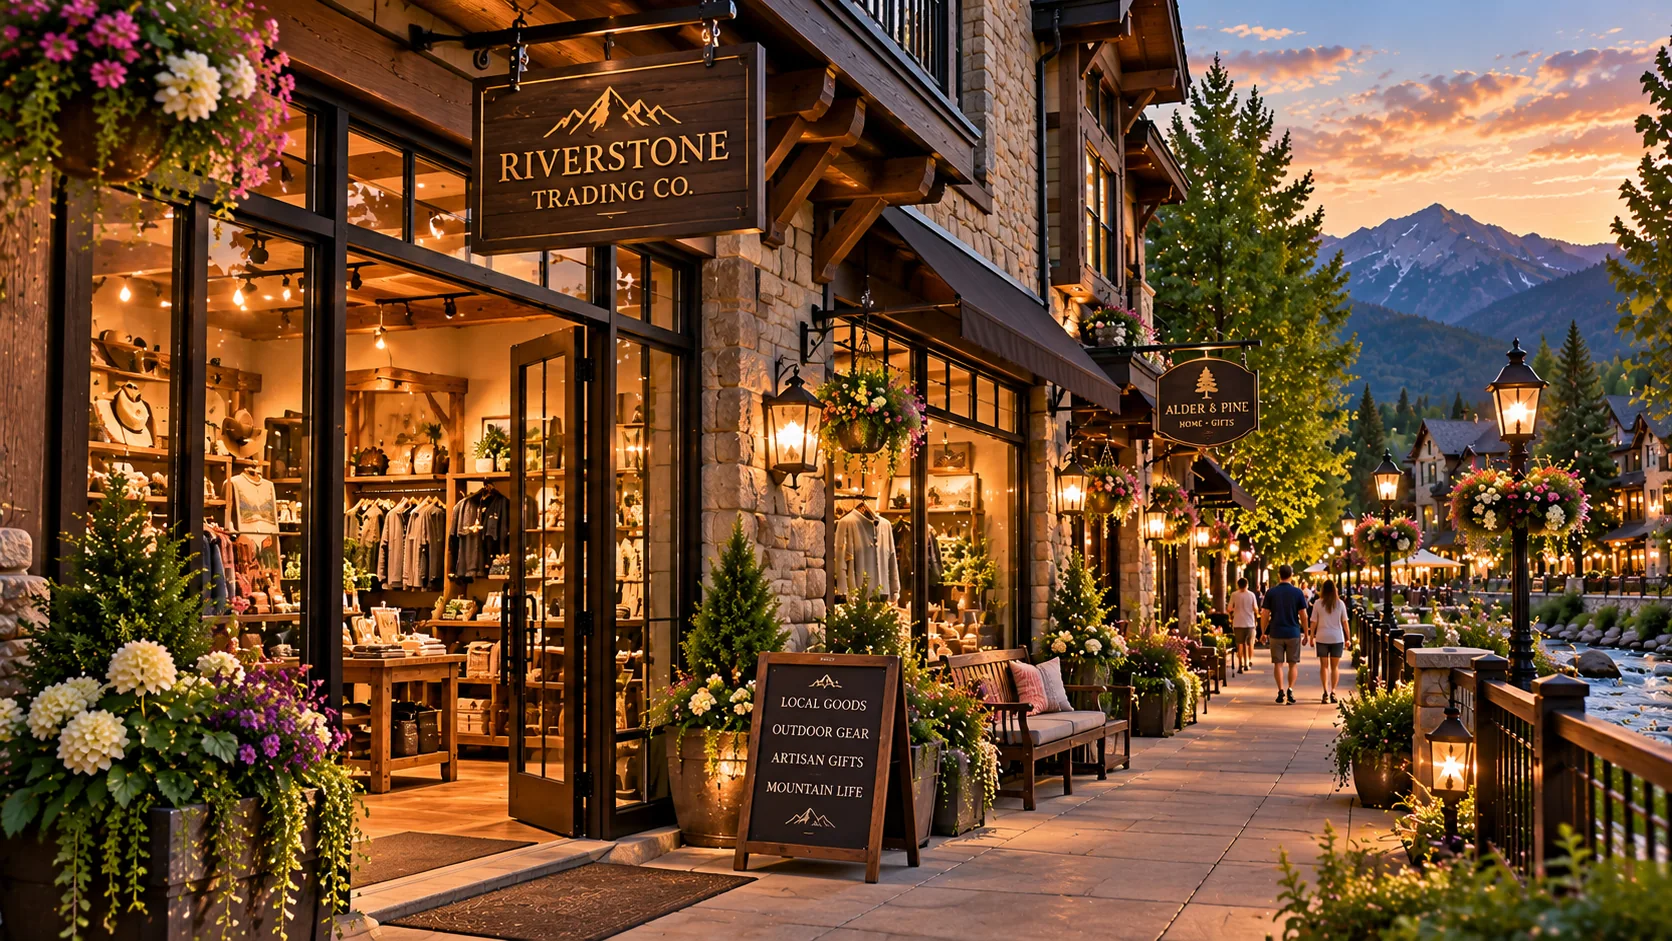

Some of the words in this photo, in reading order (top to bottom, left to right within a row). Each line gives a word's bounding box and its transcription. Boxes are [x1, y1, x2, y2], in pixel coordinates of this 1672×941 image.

[499, 130, 730, 183] RIVERSTONE
[531, 180, 645, 210] TRADING
[653, 176, 694, 198] CO.
[1165, 403, 1206, 416] ALDER
[1209, 402, 1217, 414] &
[1221, 401, 1249, 413] PINE
[1179, 419, 1203, 429] HOME
[780, 696, 820, 709] LOCAL
[823, 698, 867, 712] GOODS
[772, 723, 833, 738] OUTDOOR
[836, 726, 869, 740] GEAR
[771, 752, 825, 766] ARTISAN
[828, 754, 864, 769] GIFTS
[766, 781, 833, 796] MOUNTAIN
[836, 785, 863, 798] LIFE
